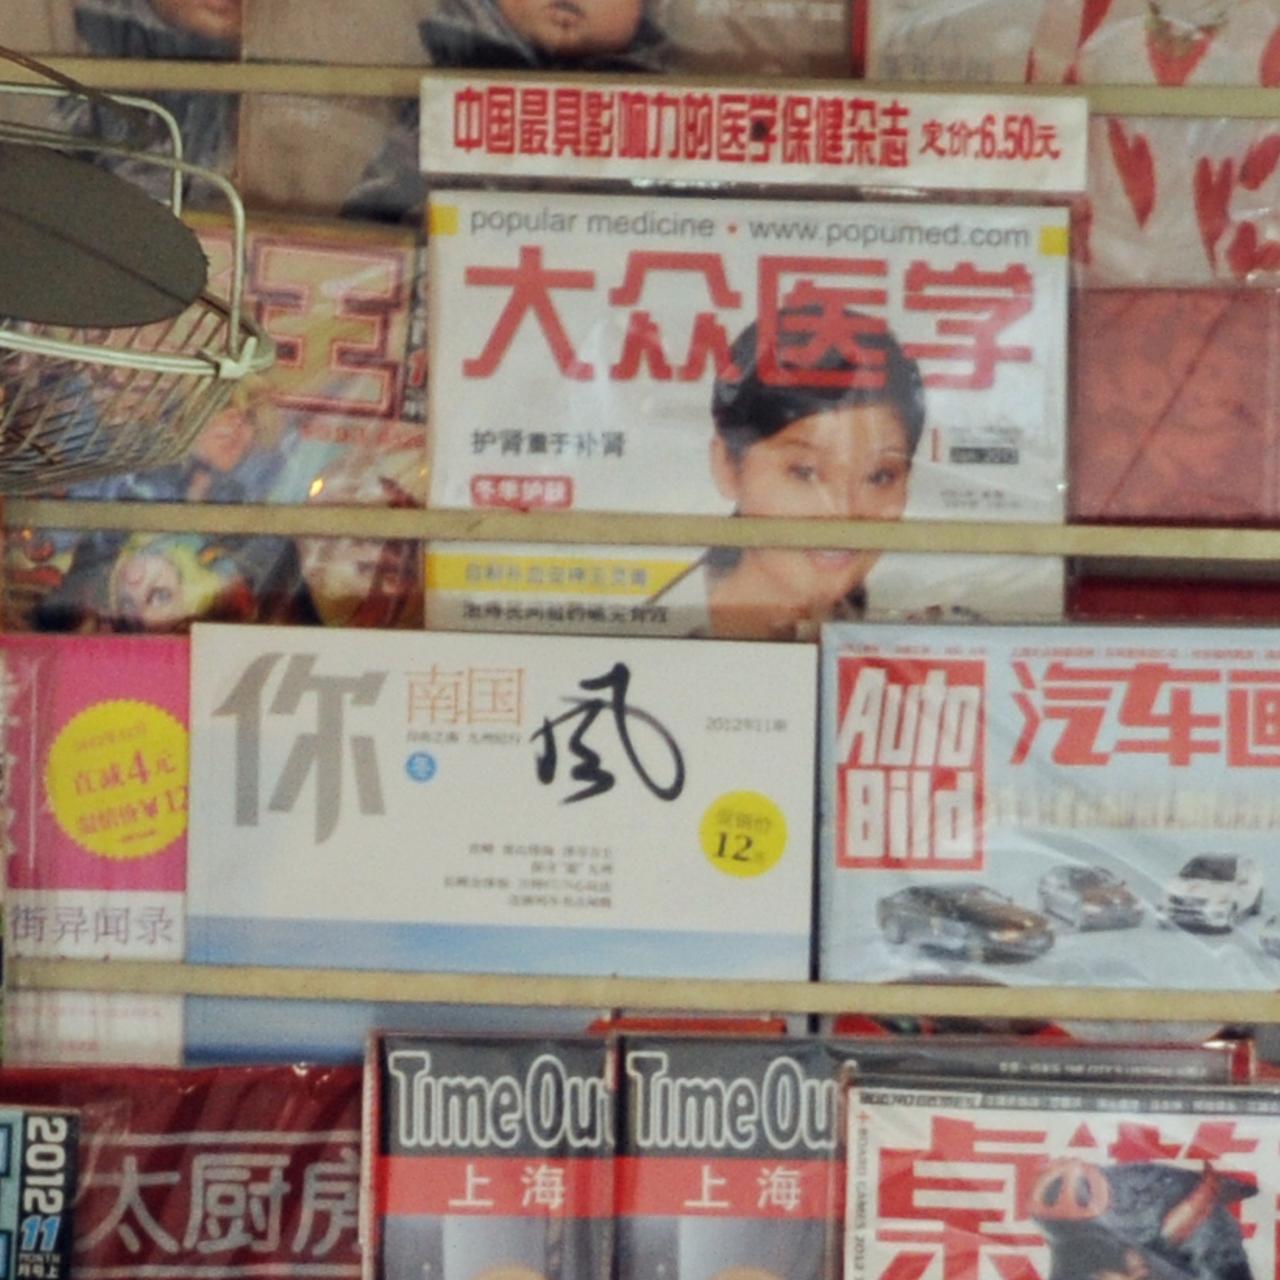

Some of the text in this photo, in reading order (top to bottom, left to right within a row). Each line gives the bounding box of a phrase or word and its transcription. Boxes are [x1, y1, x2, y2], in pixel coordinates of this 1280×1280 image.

[453, 86, 910, 168] 中国最具影响力的医学保健杂志
[470, 205, 1031, 249] popular medicine www.popumed.com
[462, 244, 1034, 392] 大众医学
[404, 662, 528, 727] 南国
[838, 664, 980, 766] Auto
[210, 652, 390, 845] 你
[844, 766, 977, 862] Bild
[387, 1050, 519, 1150] Time
[625, 1050, 756, 1150] Time
[22, 1116, 67, 1214] 2012
[447, 1164, 568, 1212] 上海
[683, 1165, 801, 1212] 上海
[21, 1215, 61, 1251] 11
